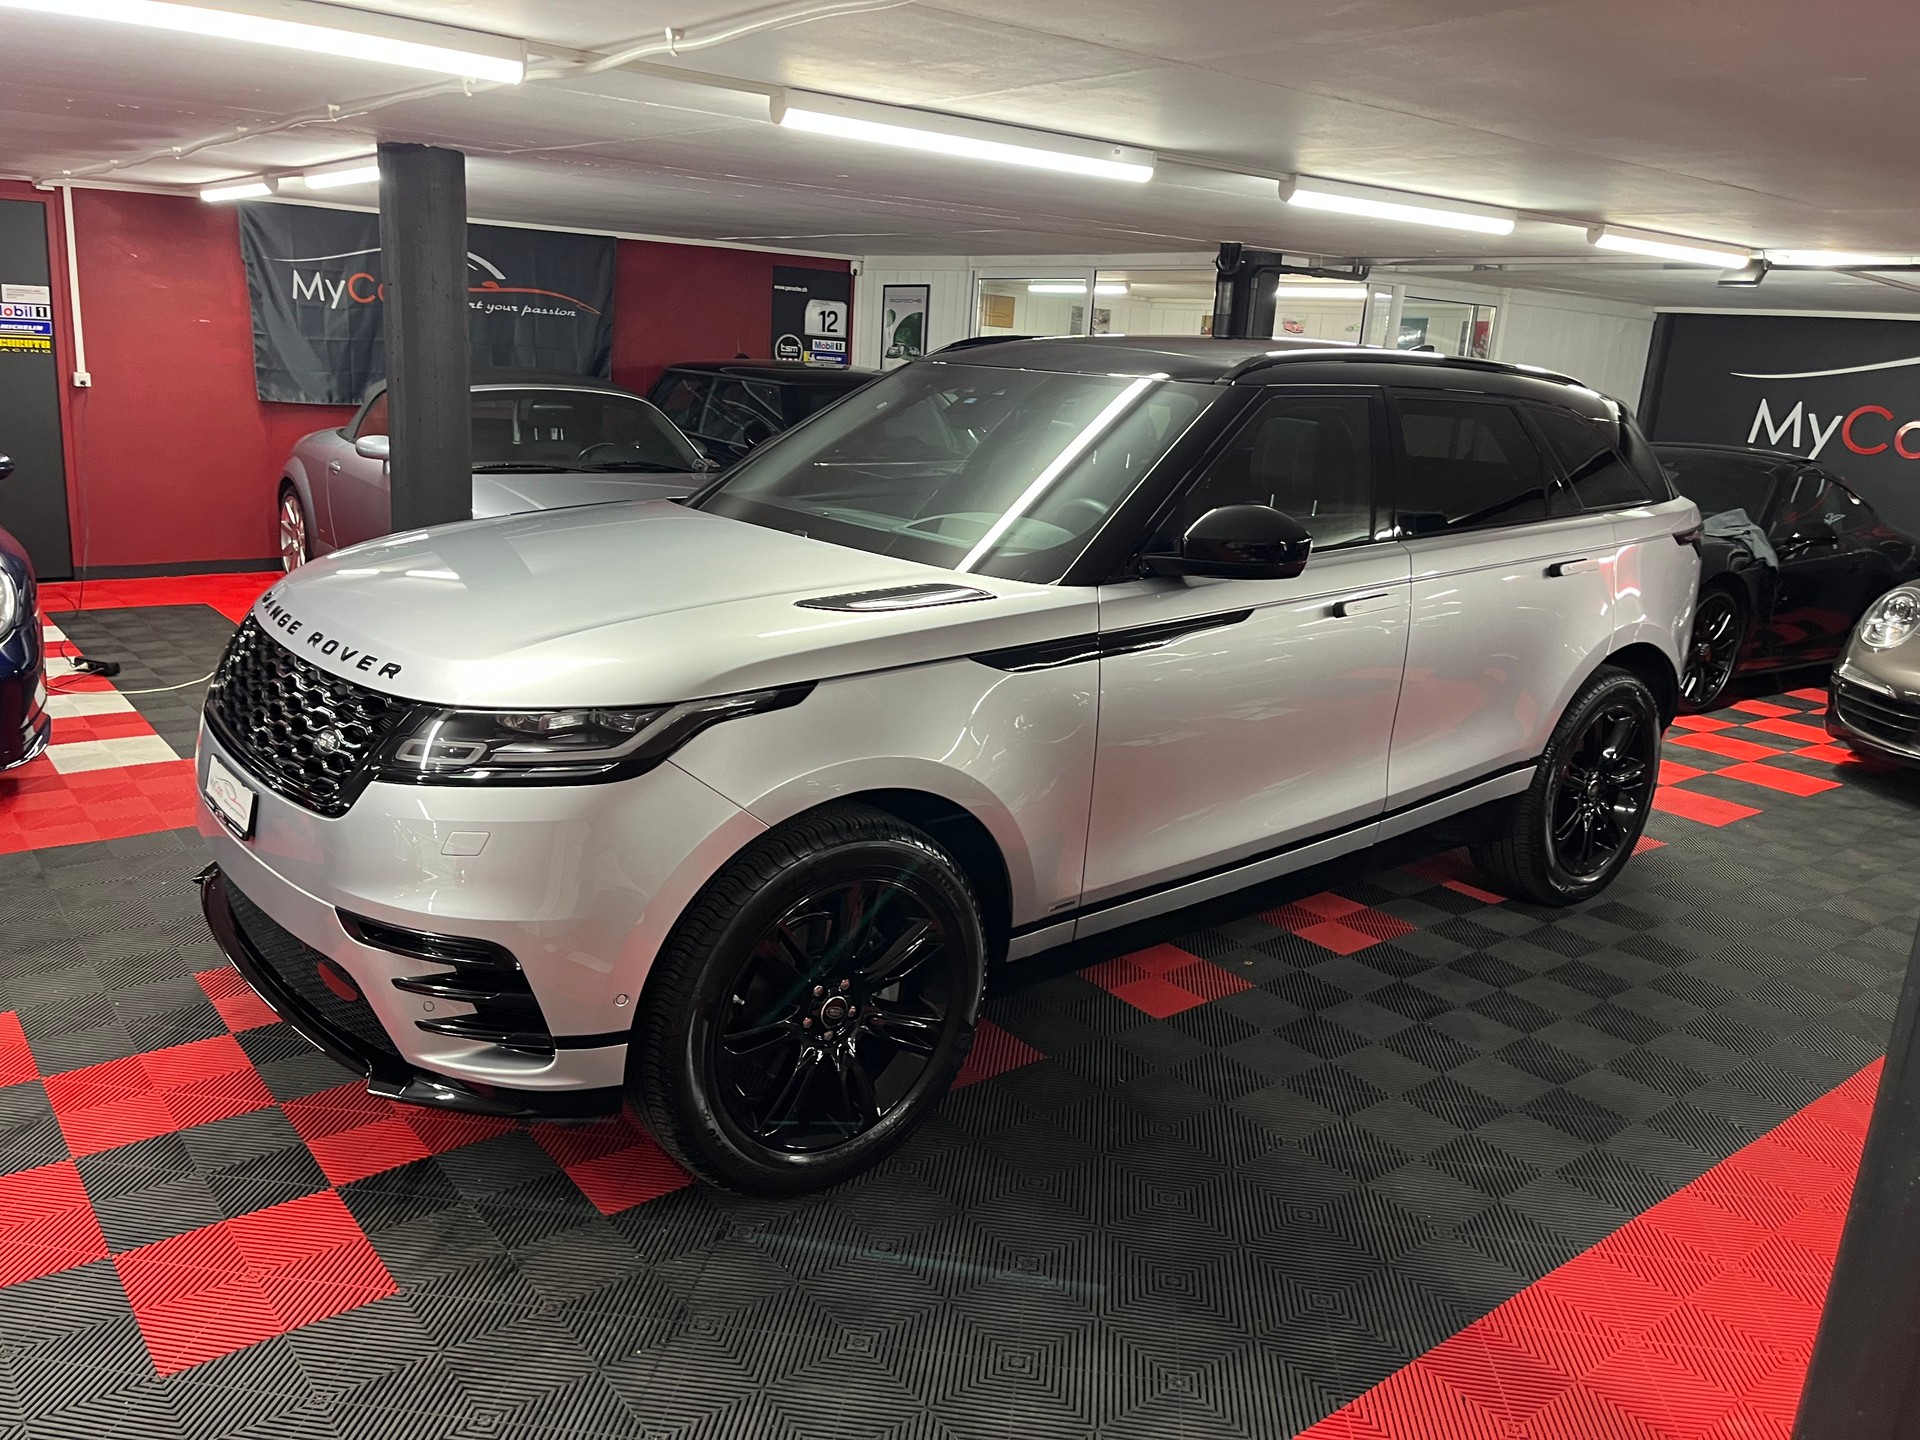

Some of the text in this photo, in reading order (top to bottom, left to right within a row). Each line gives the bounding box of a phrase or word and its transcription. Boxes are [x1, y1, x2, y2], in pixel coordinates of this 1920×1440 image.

[292, 269, 384, 309] MyC
[0, 304, 47, 317] obil 1
[485, 302, 519, 314] your
[521, 305, 576, 317] passion
[817, 310, 838, 334] 12
[814, 341, 834, 351] Mobil
[307, 631, 402, 680] ROVER
